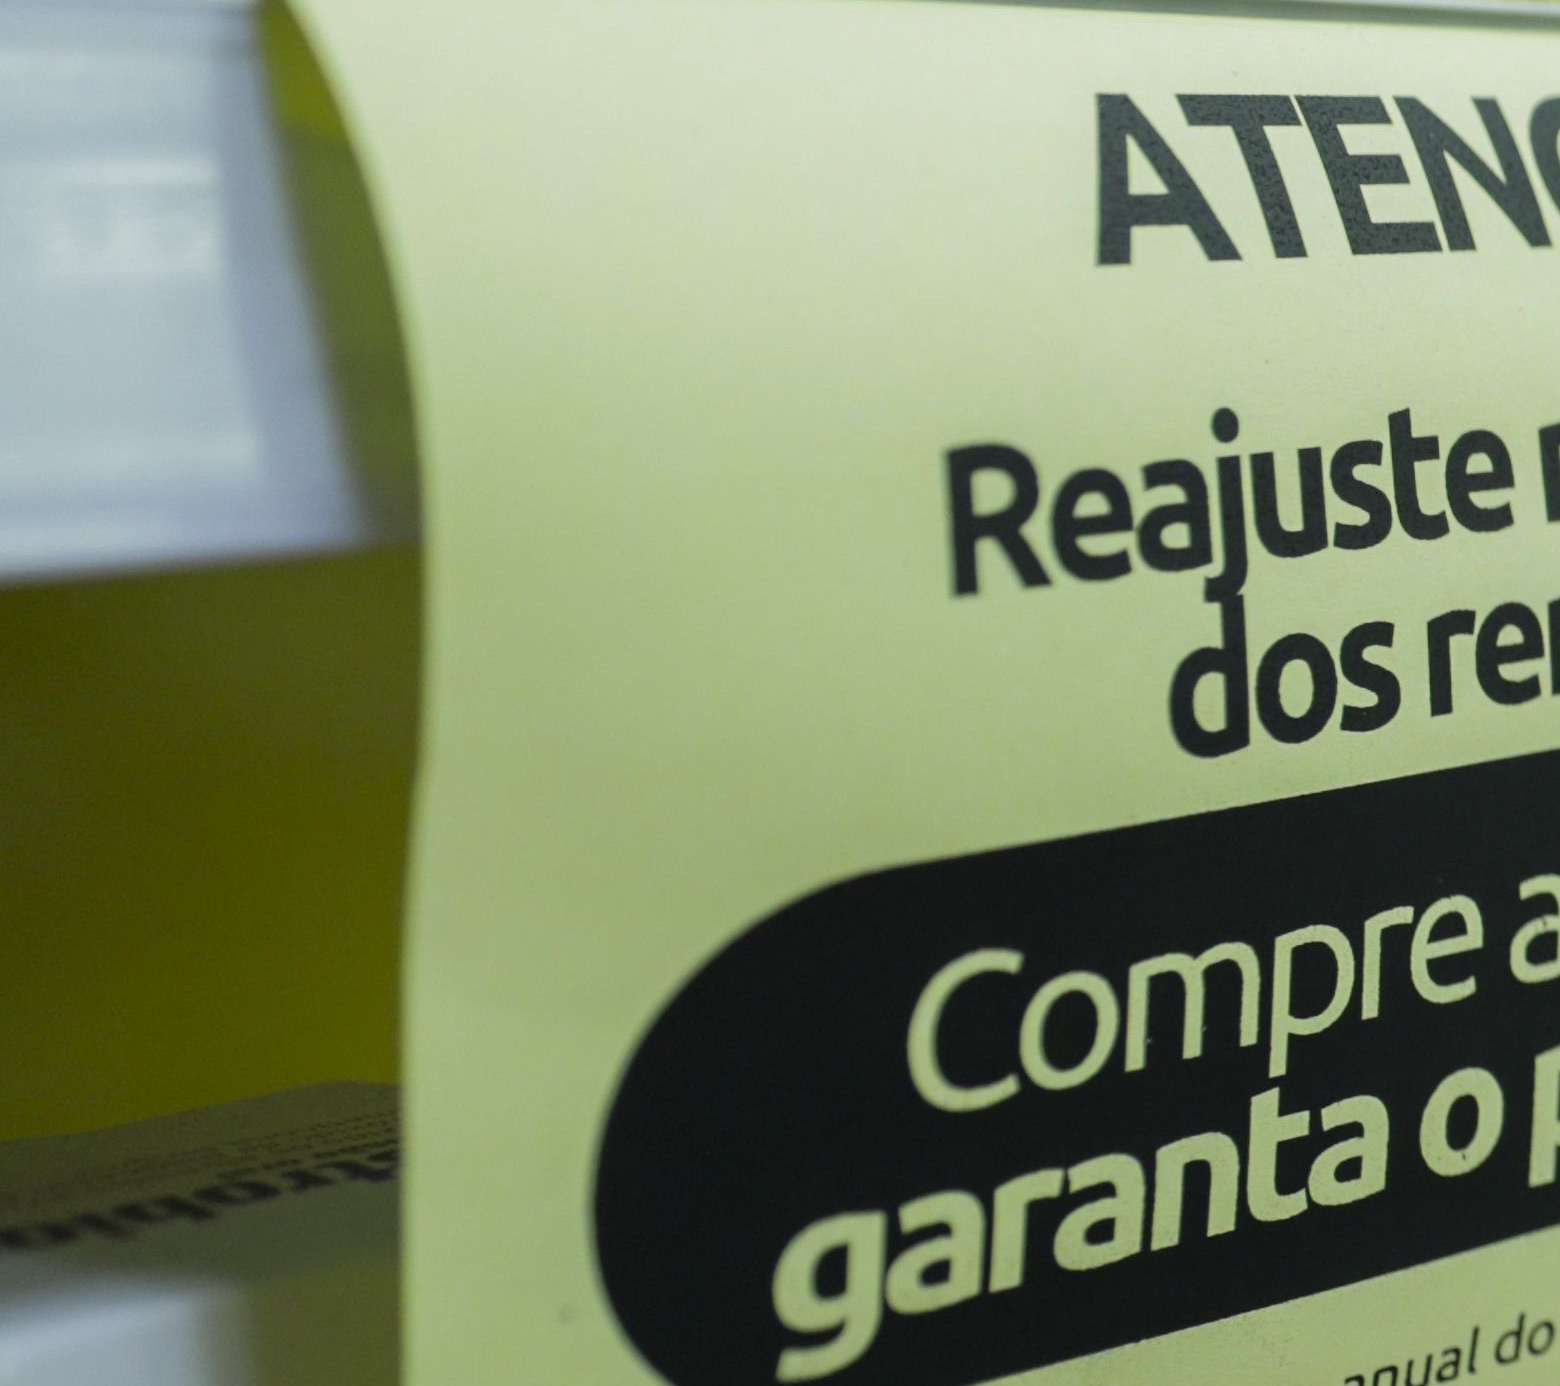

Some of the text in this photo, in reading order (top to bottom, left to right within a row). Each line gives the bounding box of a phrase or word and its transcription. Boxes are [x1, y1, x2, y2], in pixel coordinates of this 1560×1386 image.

[943, 407, 1515, 600] Reajuste
[1167, 591, 1397, 759] dos
[906, 883, 1484, 1114] Compre
[772, 1087, 1390, 1385] garanta
[1420, 1069, 1505, 1181] o
[1493, 1310, 1555, 1366] do
